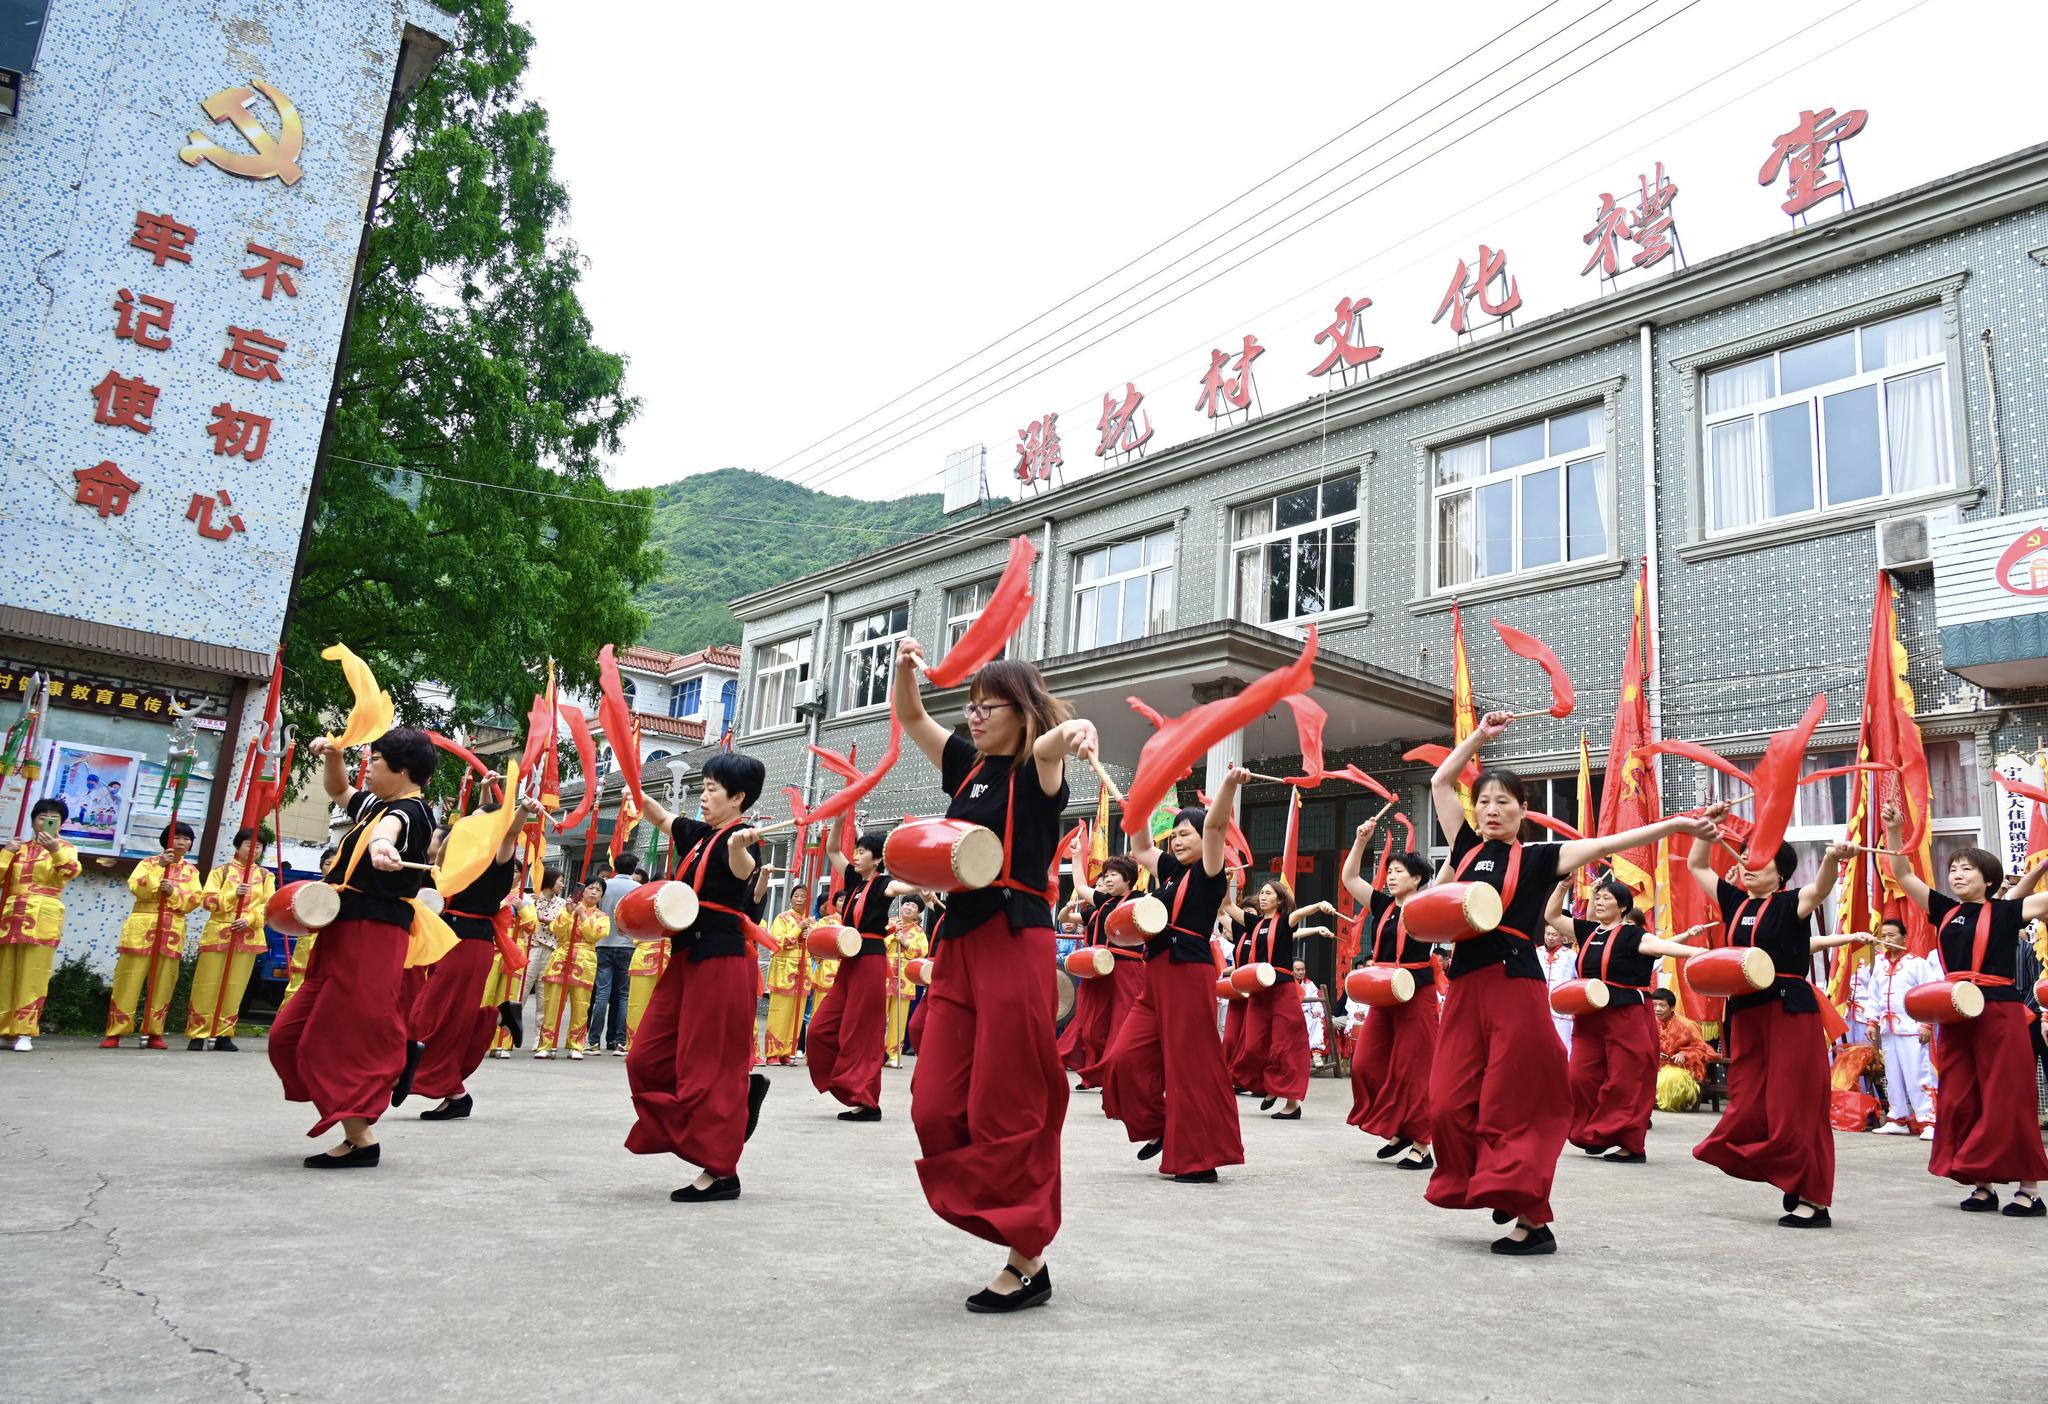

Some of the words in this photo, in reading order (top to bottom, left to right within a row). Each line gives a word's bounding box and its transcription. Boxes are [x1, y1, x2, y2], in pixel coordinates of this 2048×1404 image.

[73, 210, 196, 519] 牢记使命
[185, 242, 304, 541] 不忘初心
